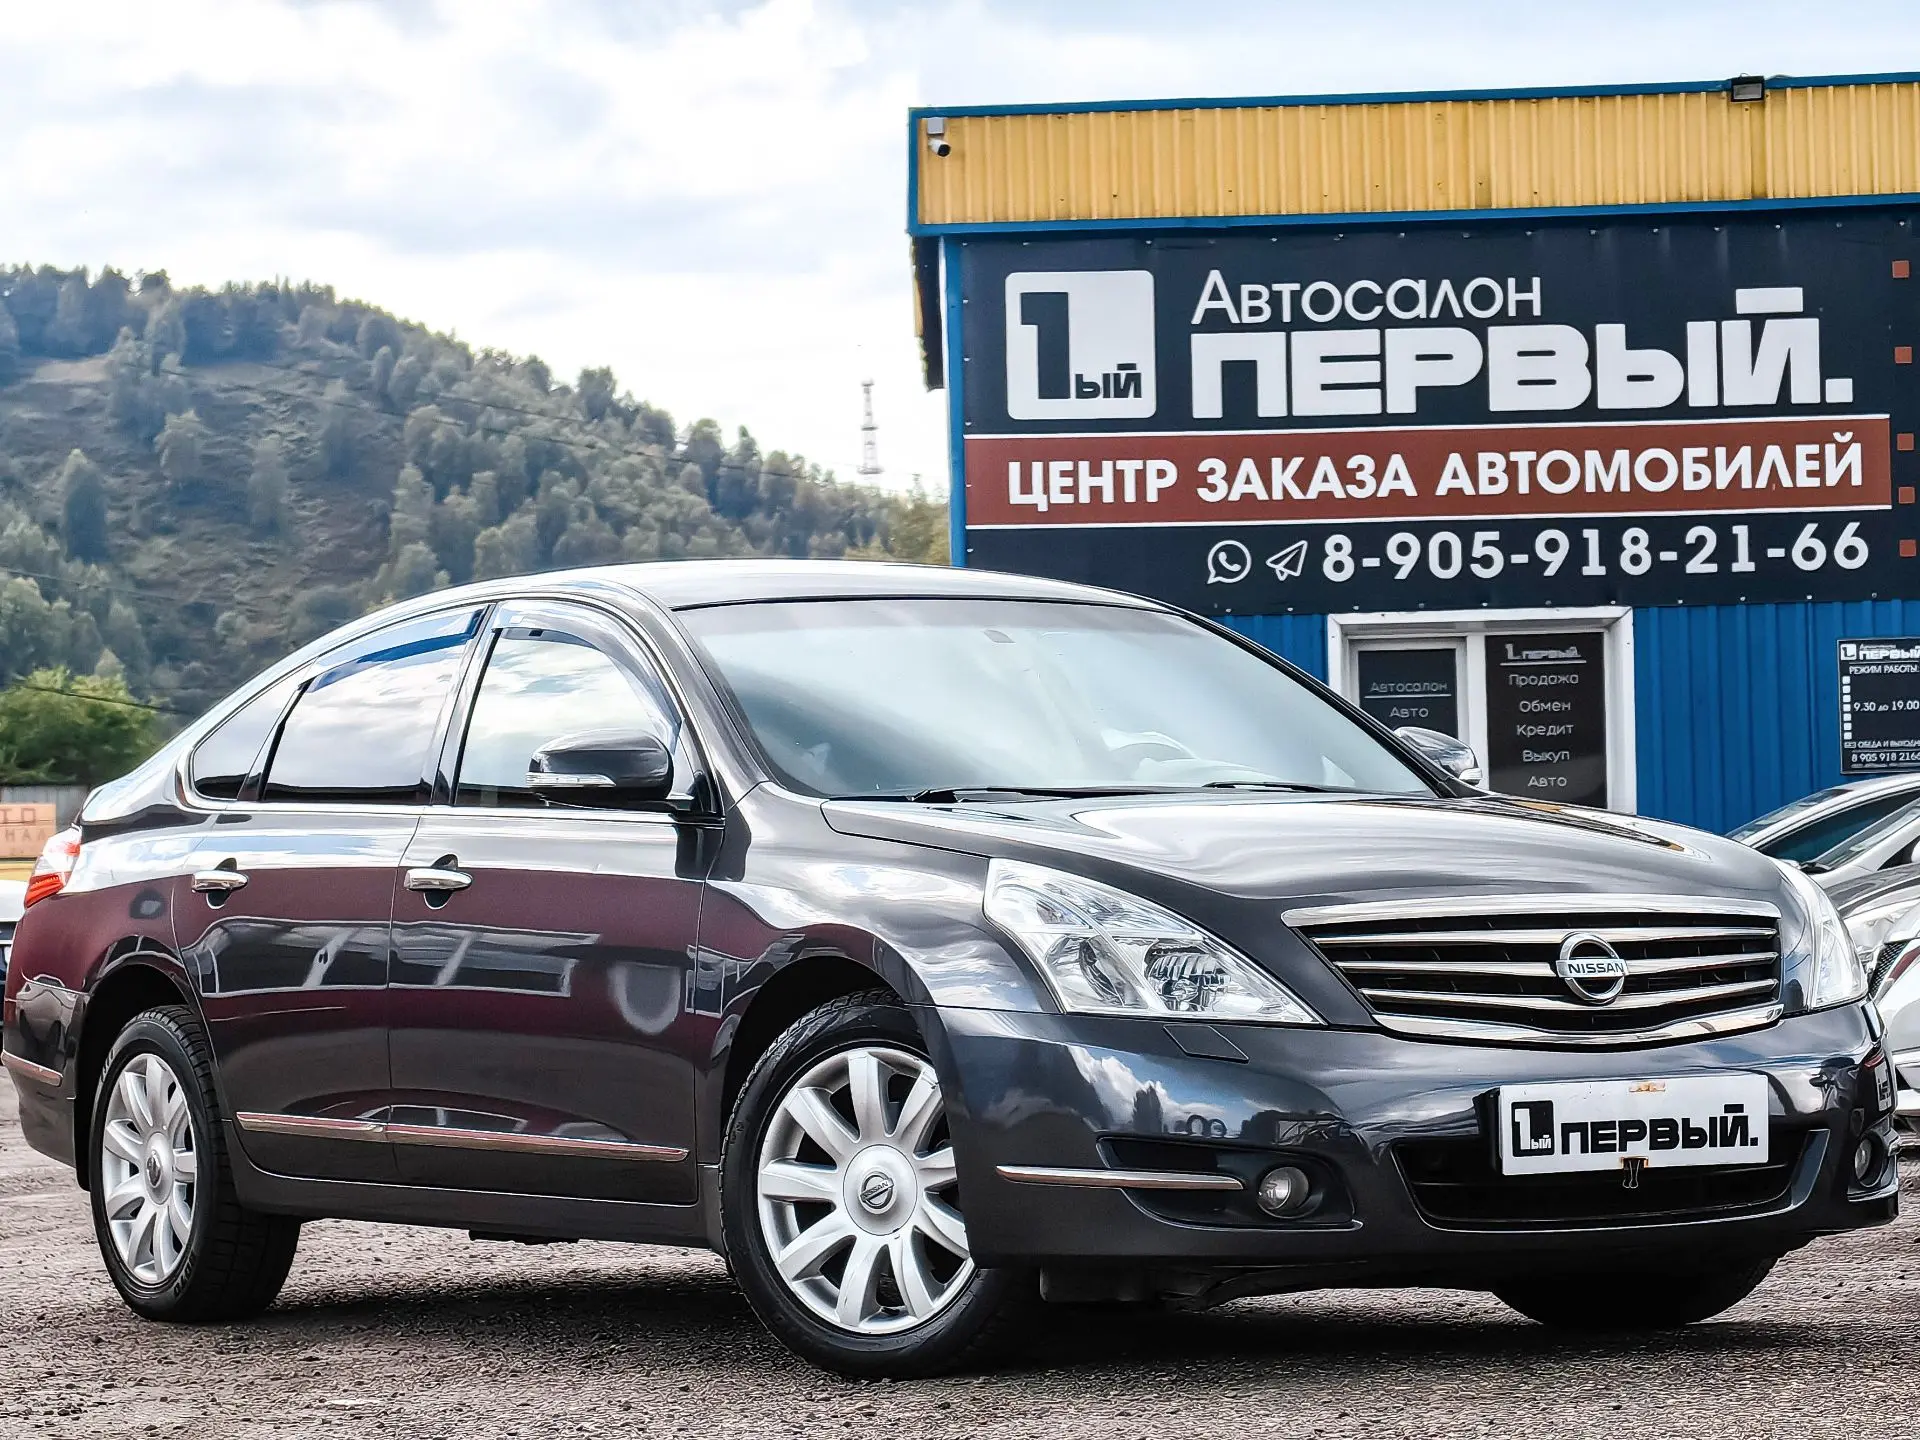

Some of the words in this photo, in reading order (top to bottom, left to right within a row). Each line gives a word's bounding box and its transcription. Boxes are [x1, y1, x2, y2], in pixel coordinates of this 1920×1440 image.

[1191, 286, 1853, 419] ПЕРВЫЙ.
[1008, 459, 1178, 512] ЦЕНТР
[1197, 453, 1418, 502] ЗАКАЗА
[1435, 432, 1863, 496] АВТОМОБИЛЕЙ
[1322, 522, 1869, 582] 8-905-918-21-66
[1849, 664, 1882, 675] РЕЖИМ
[1508, 673, 1579, 687] Продажа
[1370, 681, 1448, 694] Автосалон
[1388, 706, 1429, 718] Авто
[1519, 701, 1571, 713] Обмен
[1853, 701, 1876, 712] 9.30
[1891, 700, 1920, 711] 19.00
[1516, 724, 1574, 738] Кредит
[1522, 749, 1570, 763] Выкуп
[1859, 752, 1878, 763] 905
[1879, 752, 1897, 762] 918
[1527, 775, 1567, 788] Авто
[1567, 962, 1625, 974] NISSAN
[1560, 1103, 1759, 1155] ПЕРВЫЙ.
